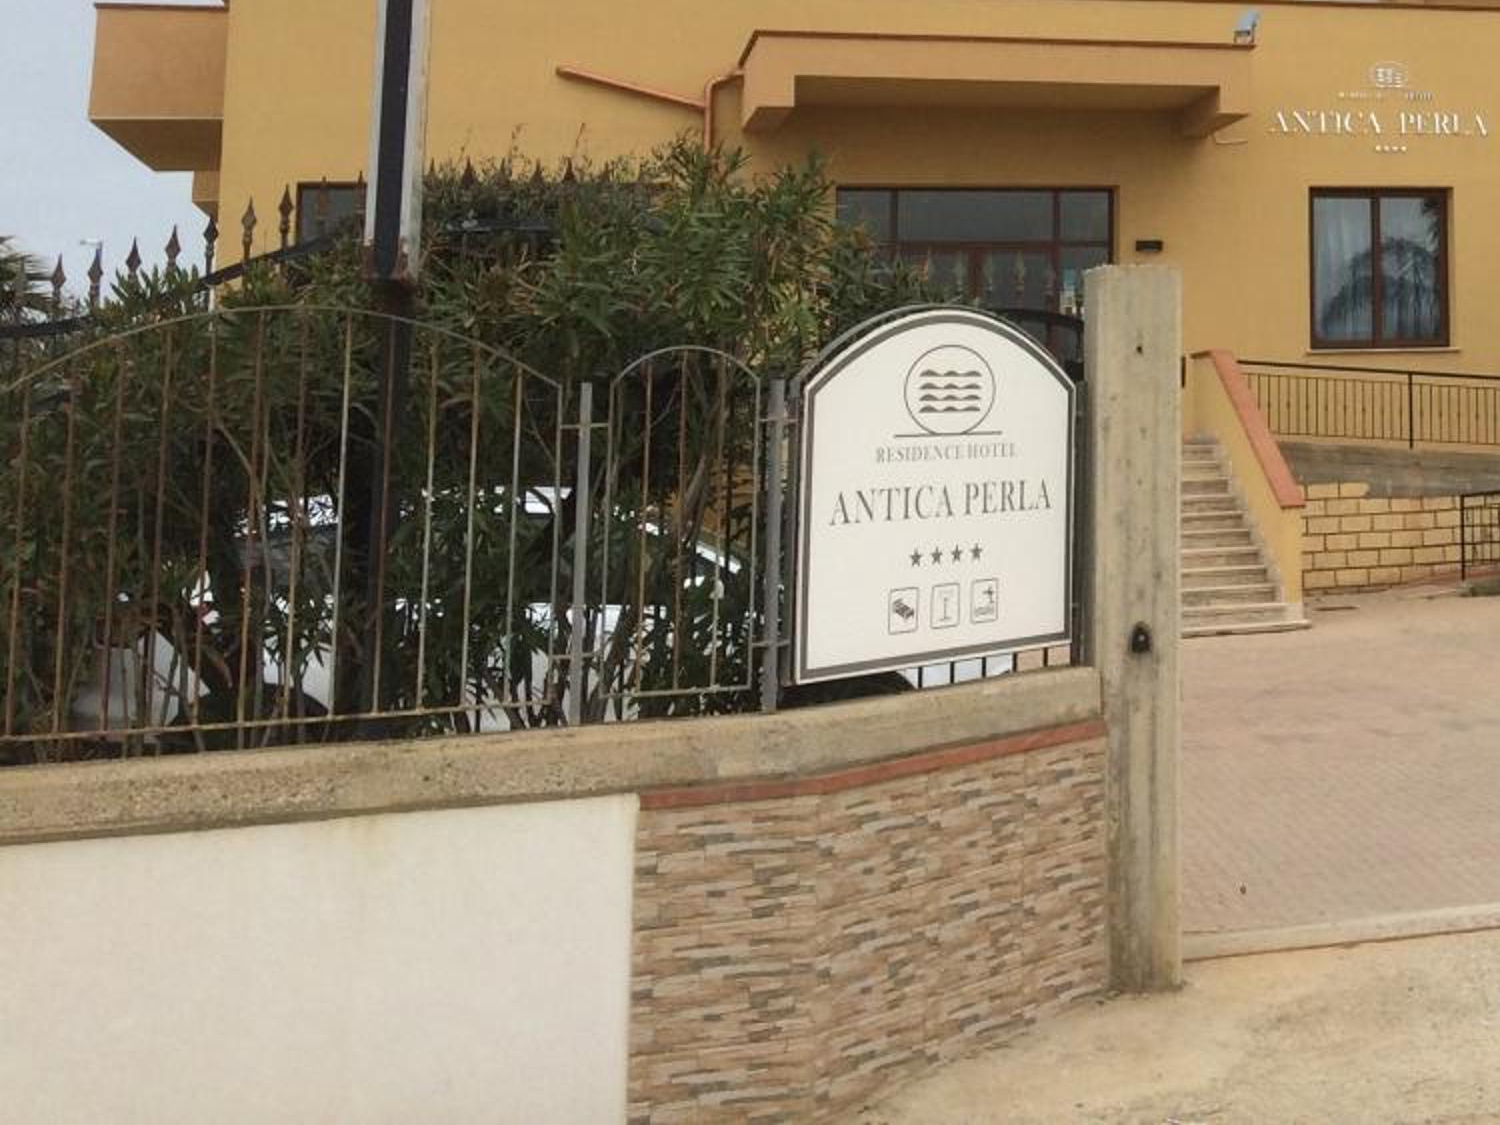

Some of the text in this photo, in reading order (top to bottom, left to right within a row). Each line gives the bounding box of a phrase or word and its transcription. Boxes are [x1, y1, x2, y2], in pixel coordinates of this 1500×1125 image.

[1268, 111, 1489, 137] ANTICA PERLA
[875, 441, 1016, 464] RESIDENCE HOTEL
[829, 477, 1052, 526] ANTICA PERLA
